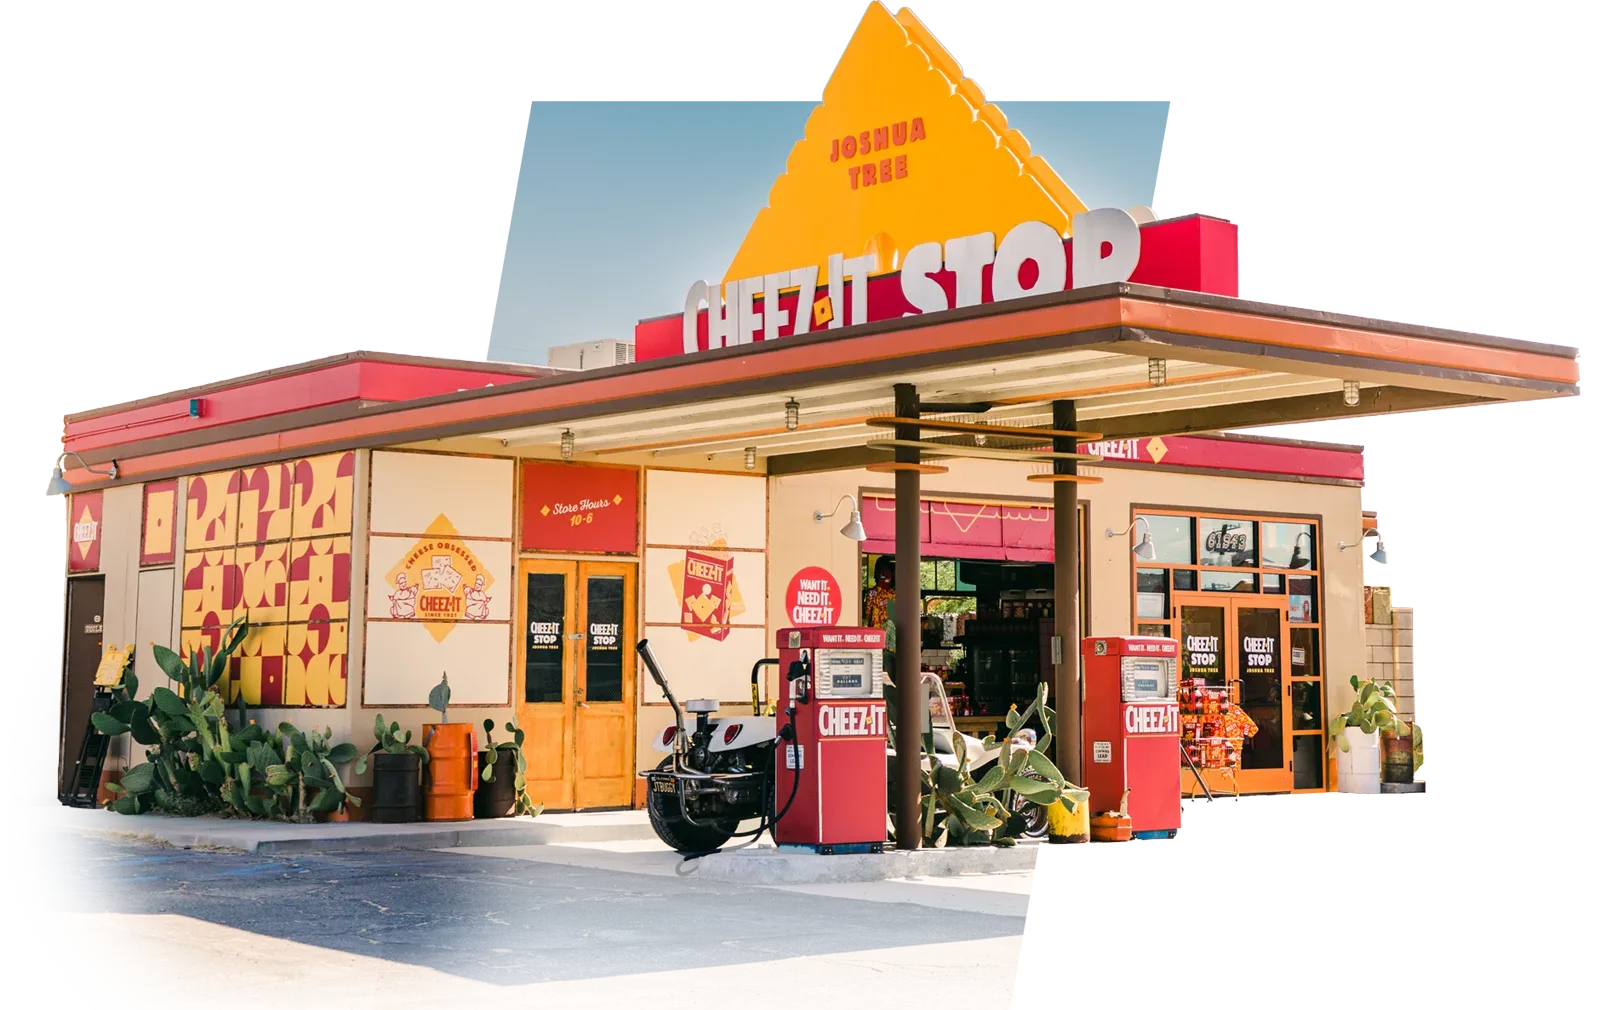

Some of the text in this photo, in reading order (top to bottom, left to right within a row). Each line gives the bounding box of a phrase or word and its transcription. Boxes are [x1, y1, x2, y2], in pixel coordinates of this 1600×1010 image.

[830, 117, 926, 163] JOSHUA
[848, 154, 908, 190] TREE
[900, 207, 1142, 317] STOP
[552, 499, 611, 515] Store Hours
[570, 512, 594, 527] 10-6
[1206, 532, 1247, 552] 61943
[405, 542, 477, 572] CHEESE OBSESSED
[800, 579, 821, 591] WANT
[797, 590, 820, 606] NEED
[533, 635, 557, 644] STOP
[593, 636, 616, 645] STOP
[1191, 653, 1216, 665] STOP
[1248, 654, 1272, 666] STOP
